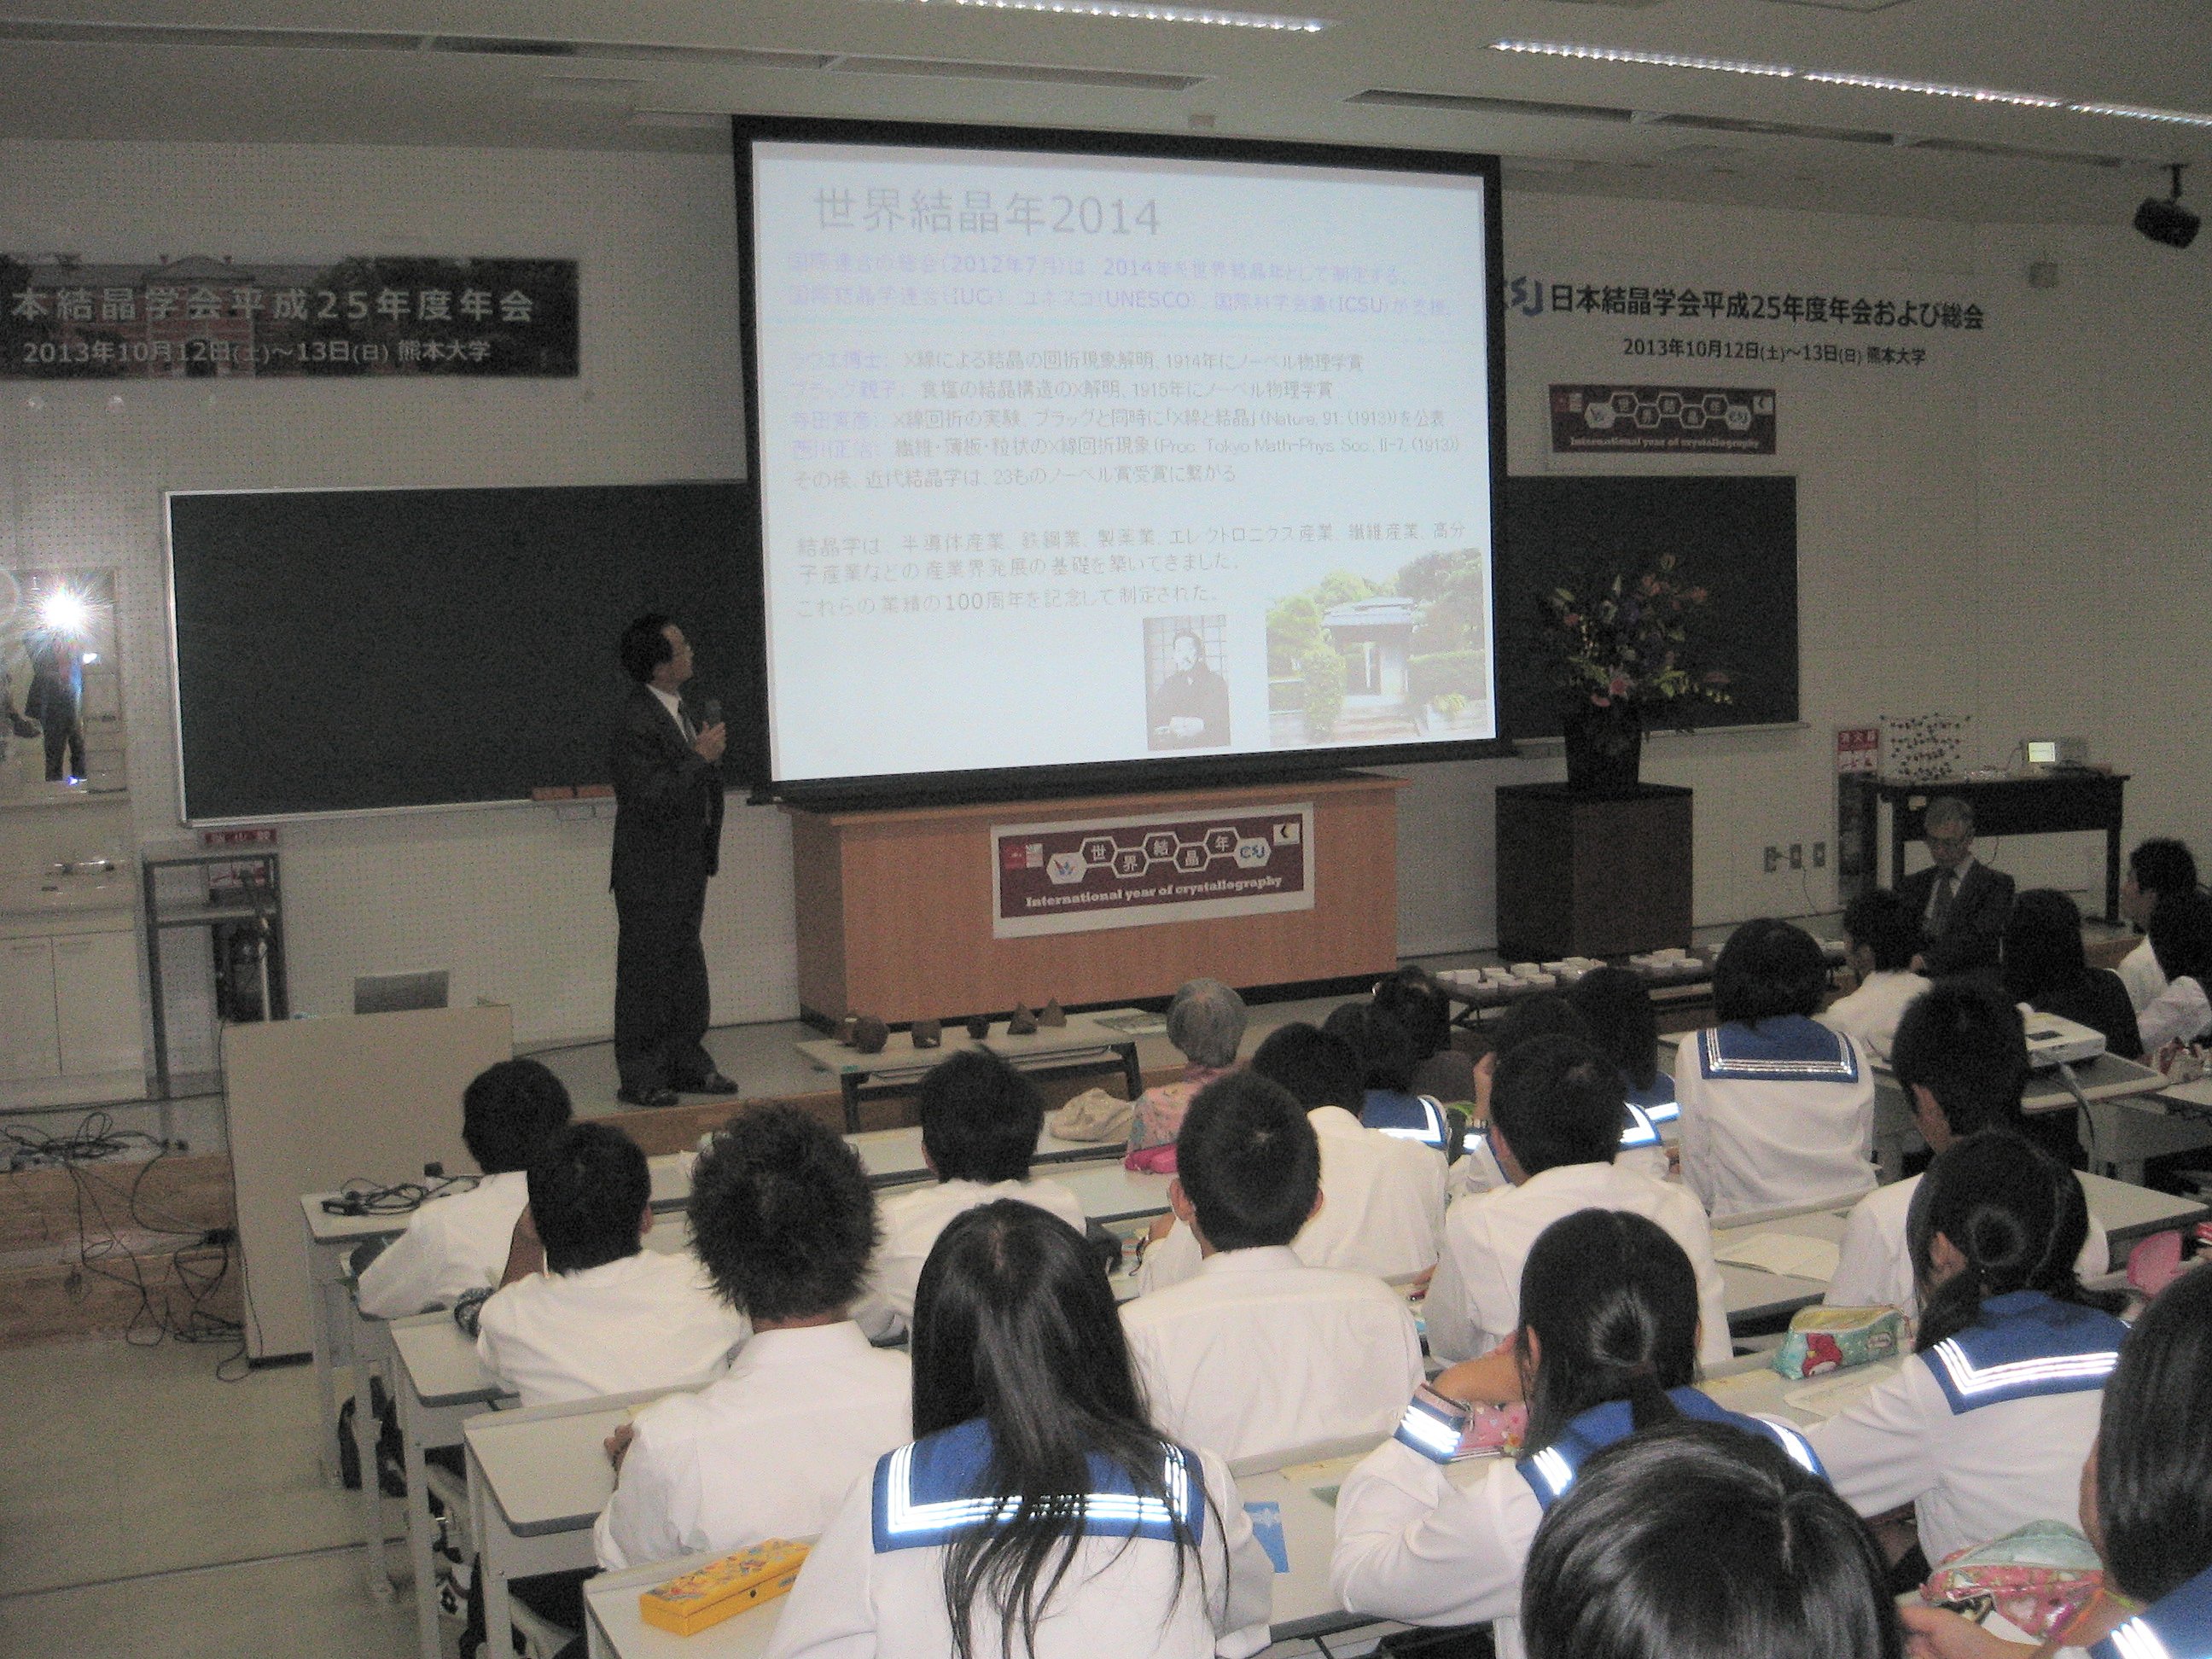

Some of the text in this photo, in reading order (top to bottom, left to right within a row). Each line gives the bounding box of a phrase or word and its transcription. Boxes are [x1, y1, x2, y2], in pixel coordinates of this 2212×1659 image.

[813, 187, 1161, 236] 世界結晶年2014
[11, 286, 533, 323] 本結晶学会平成25年度年会
[1551, 284, 1984, 329] 日本結晶学会平成25年度年会および総会
[398, 341, 492, 364] 熊本大学
[1866, 346, 1926, 367] 熊本大学
[1025, 875, 1283, 907] International year of crystallography
